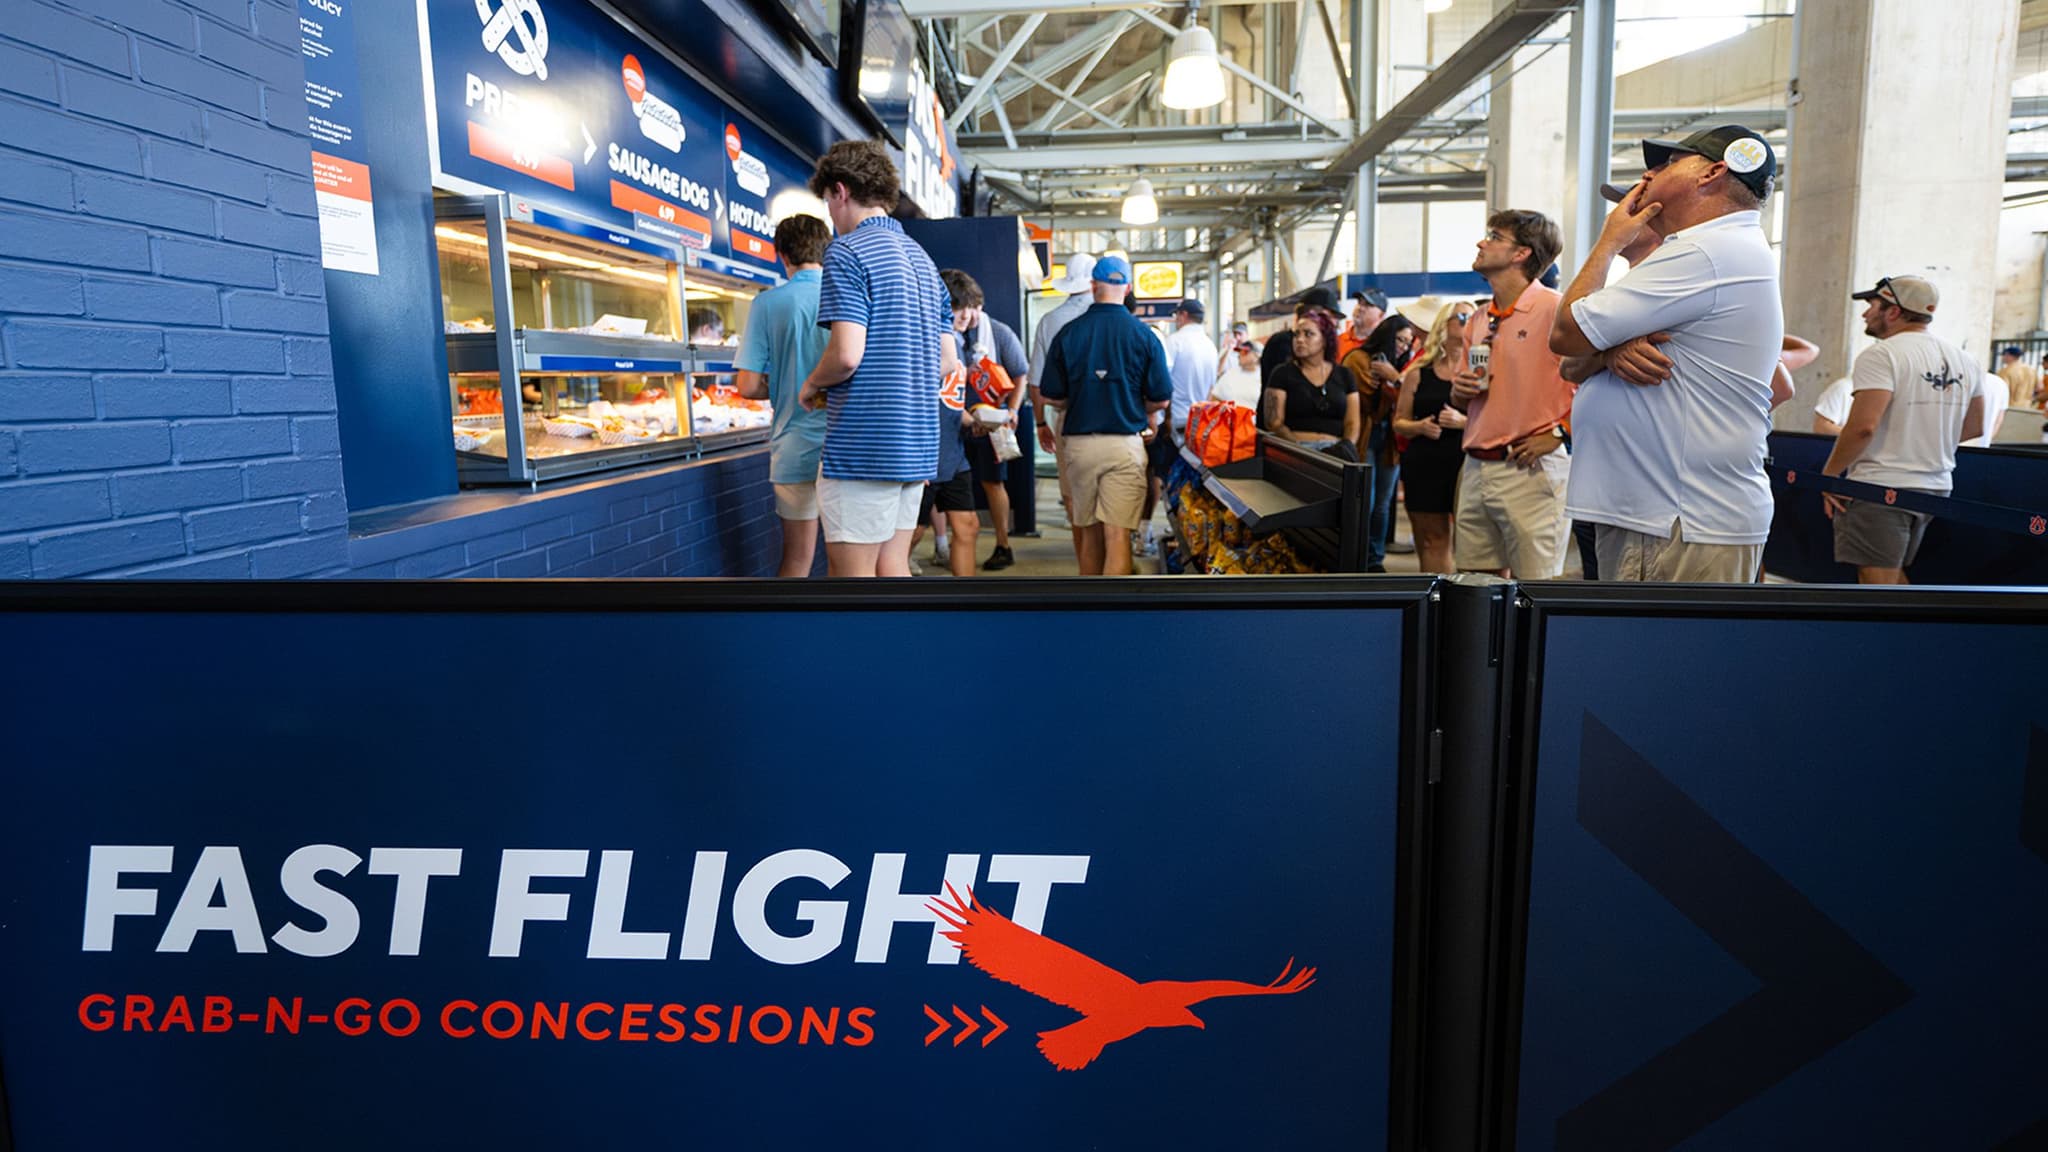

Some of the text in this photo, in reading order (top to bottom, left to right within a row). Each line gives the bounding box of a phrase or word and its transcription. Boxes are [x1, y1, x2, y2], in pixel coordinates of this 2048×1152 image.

[608, 141, 710, 211] SAUSAGE DOG
[729, 200, 776, 238] HOT DOG
[1472, 354, 1488, 365] Lite
[82, 844, 1090, 965] FAST FLIGHT
[78, 993, 876, 1046] GRAB-N-GO CONCESSIONS
